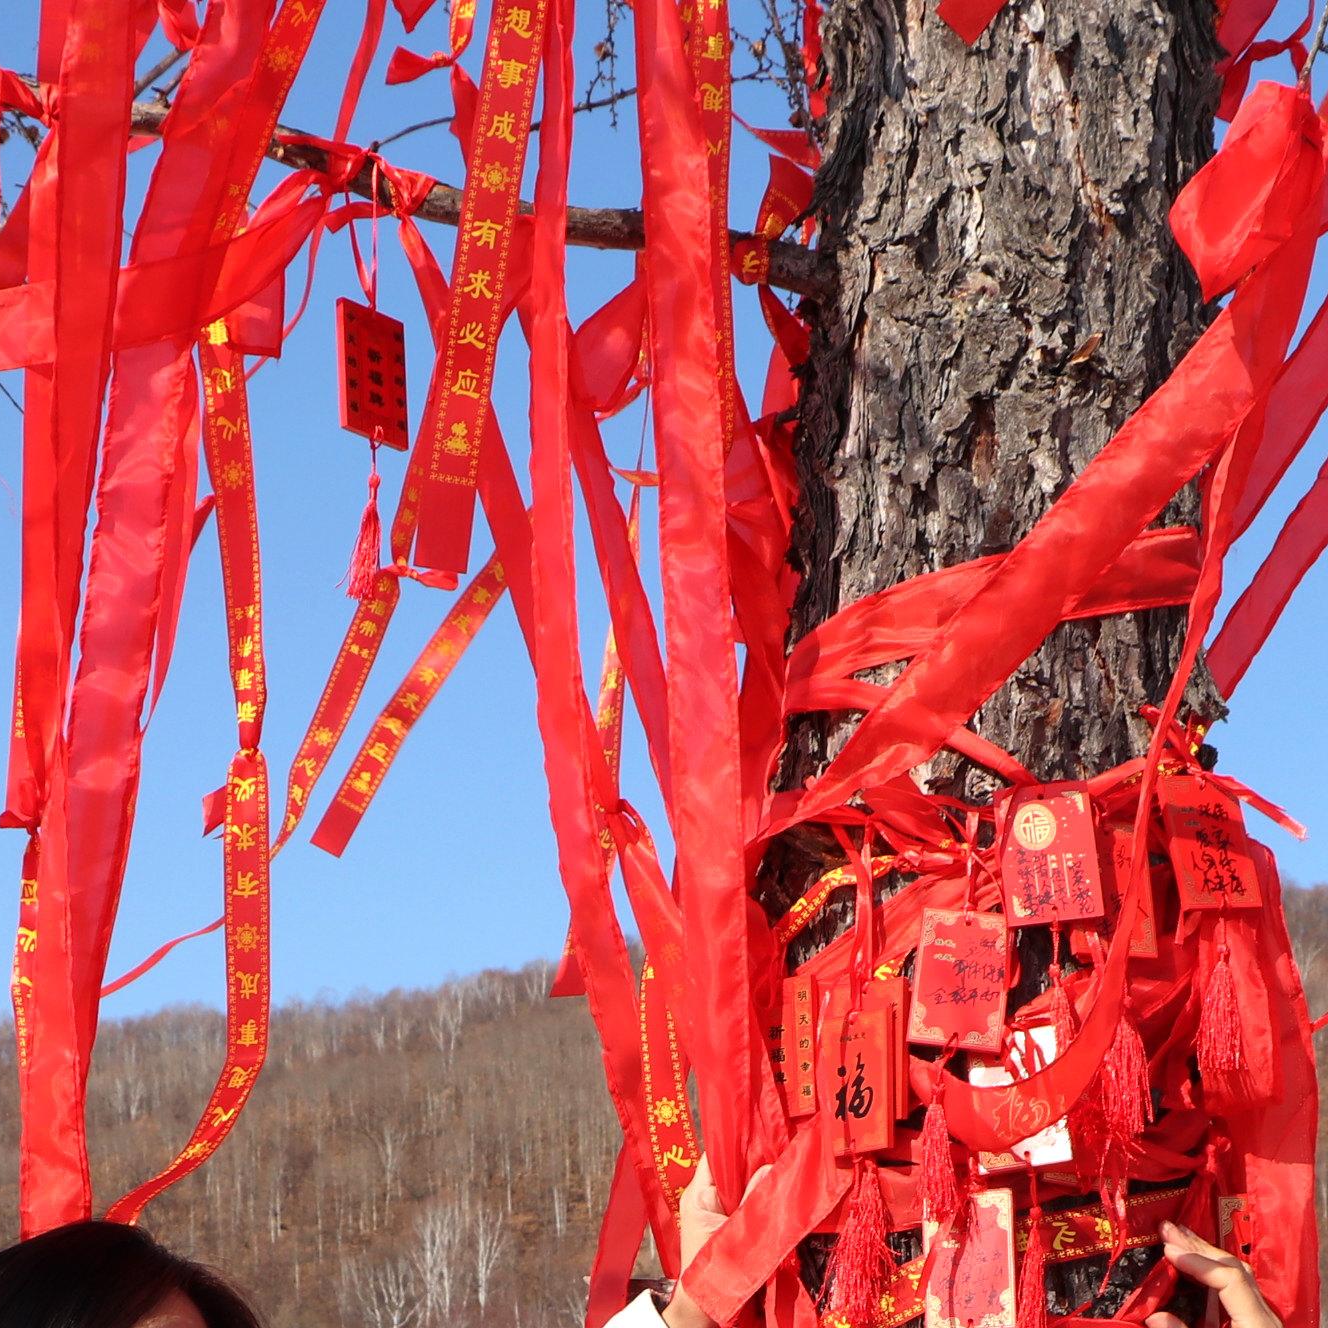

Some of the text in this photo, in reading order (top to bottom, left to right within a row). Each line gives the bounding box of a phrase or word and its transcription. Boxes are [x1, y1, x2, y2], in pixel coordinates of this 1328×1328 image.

[450, 6, 532, 400] 想事成 有求必应
[1020, 811, 1051, 843] 福
[211, 747, 261, 1128] 有求必 心想事成
[796, 990, 813, 1097] 明天的幸福
[835, 1052, 874, 1122] 福
